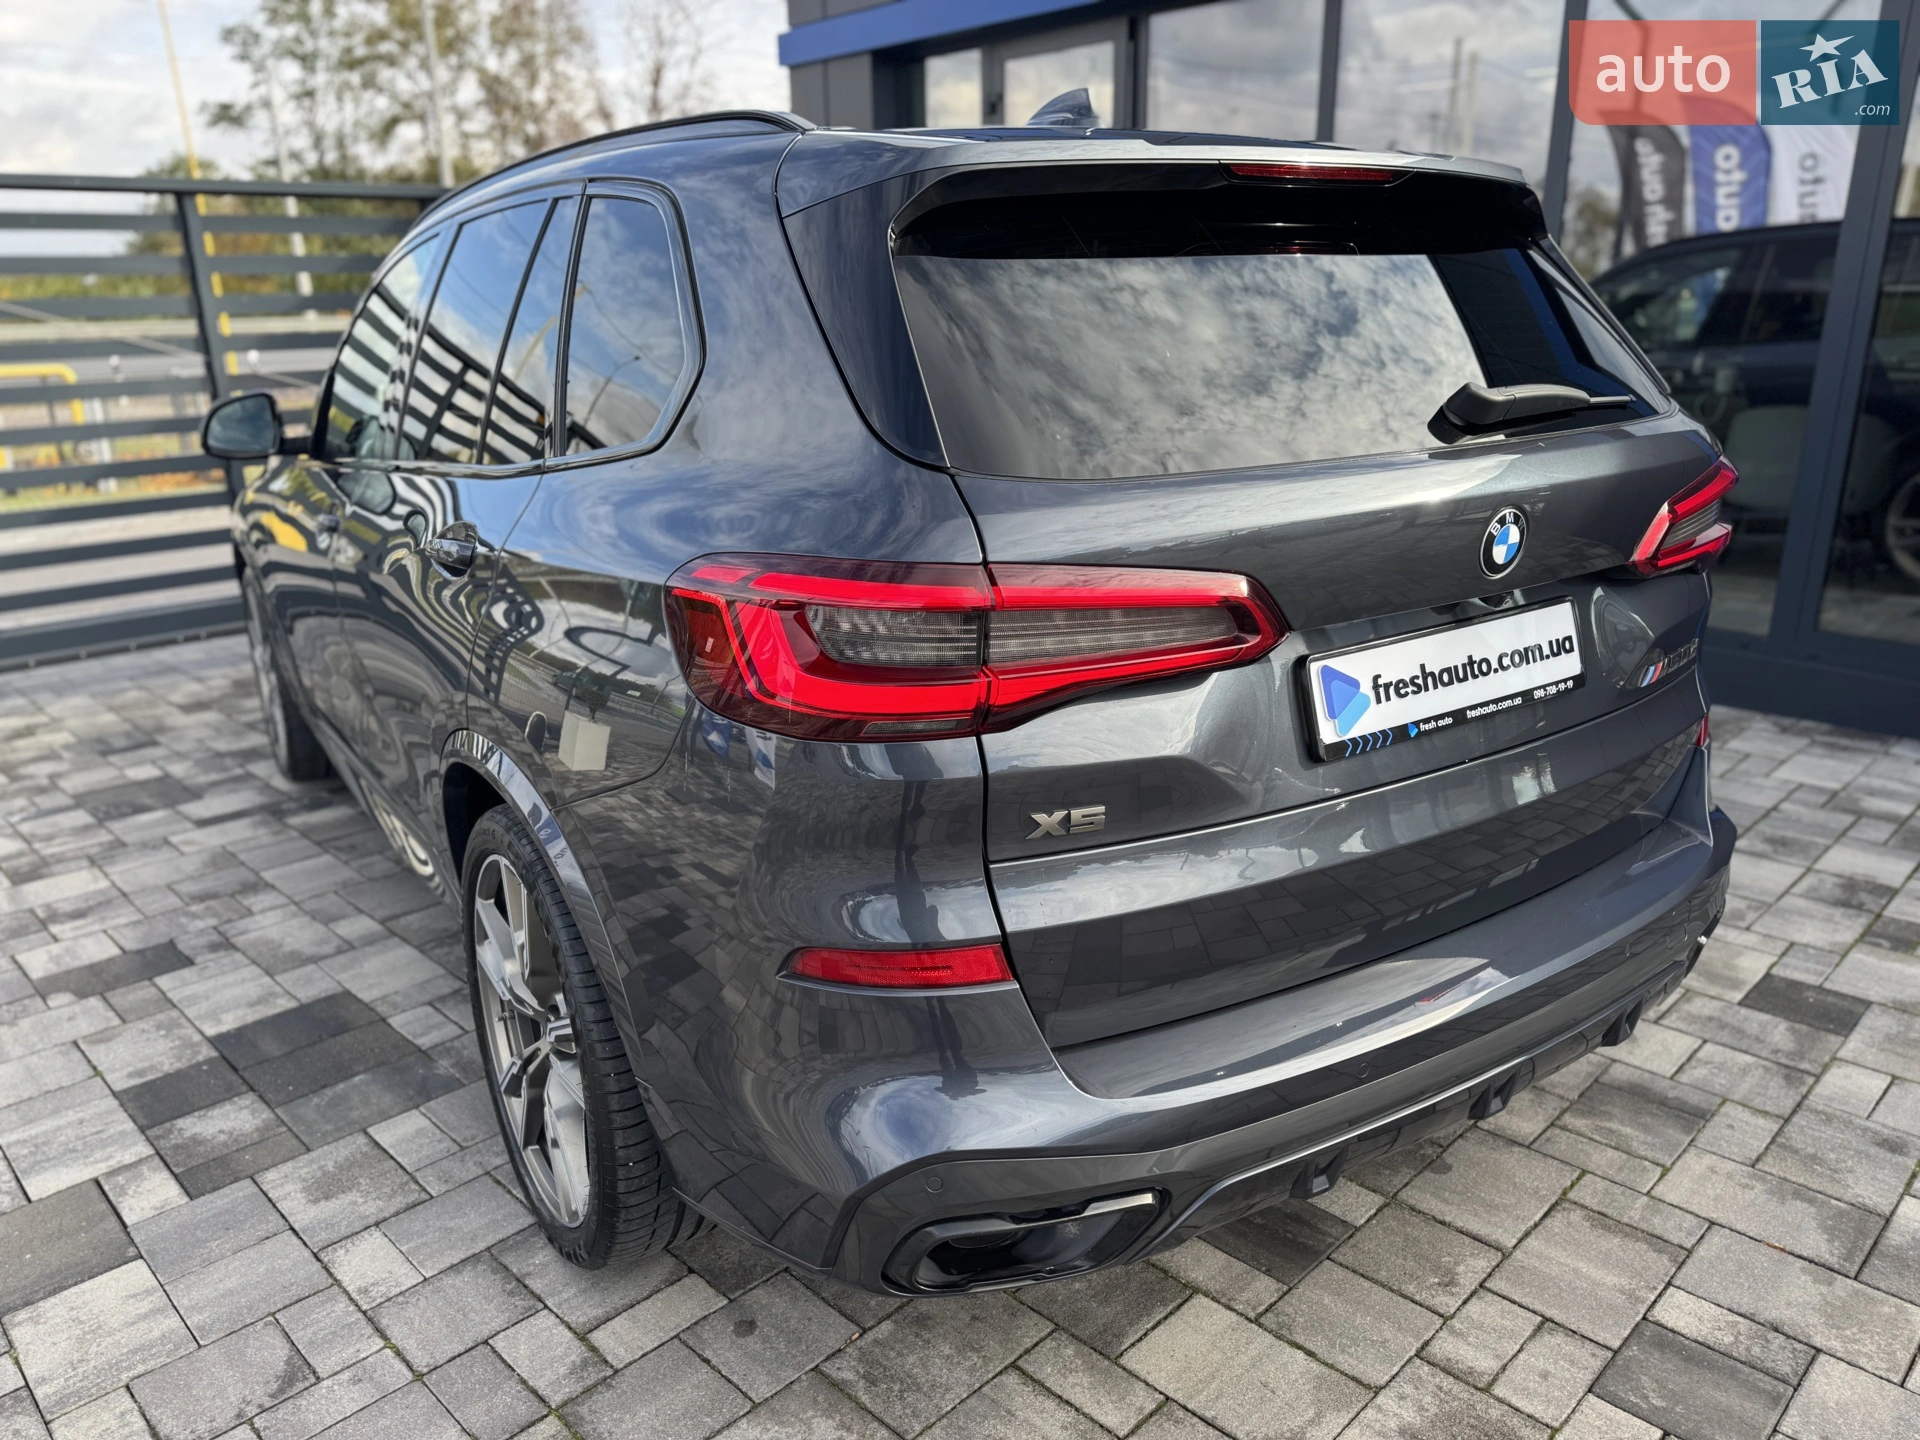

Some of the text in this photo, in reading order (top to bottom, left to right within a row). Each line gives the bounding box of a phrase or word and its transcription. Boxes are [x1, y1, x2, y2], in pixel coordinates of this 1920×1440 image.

[1372, 634, 1575, 705] freshauto.com.ua
[1419, 720, 1437, 733] fresh
[1437, 716, 1453, 727] auto
[1466, 696, 1522, 719] freshauto.com.ua
[1025, 804, 1105, 840] X5
